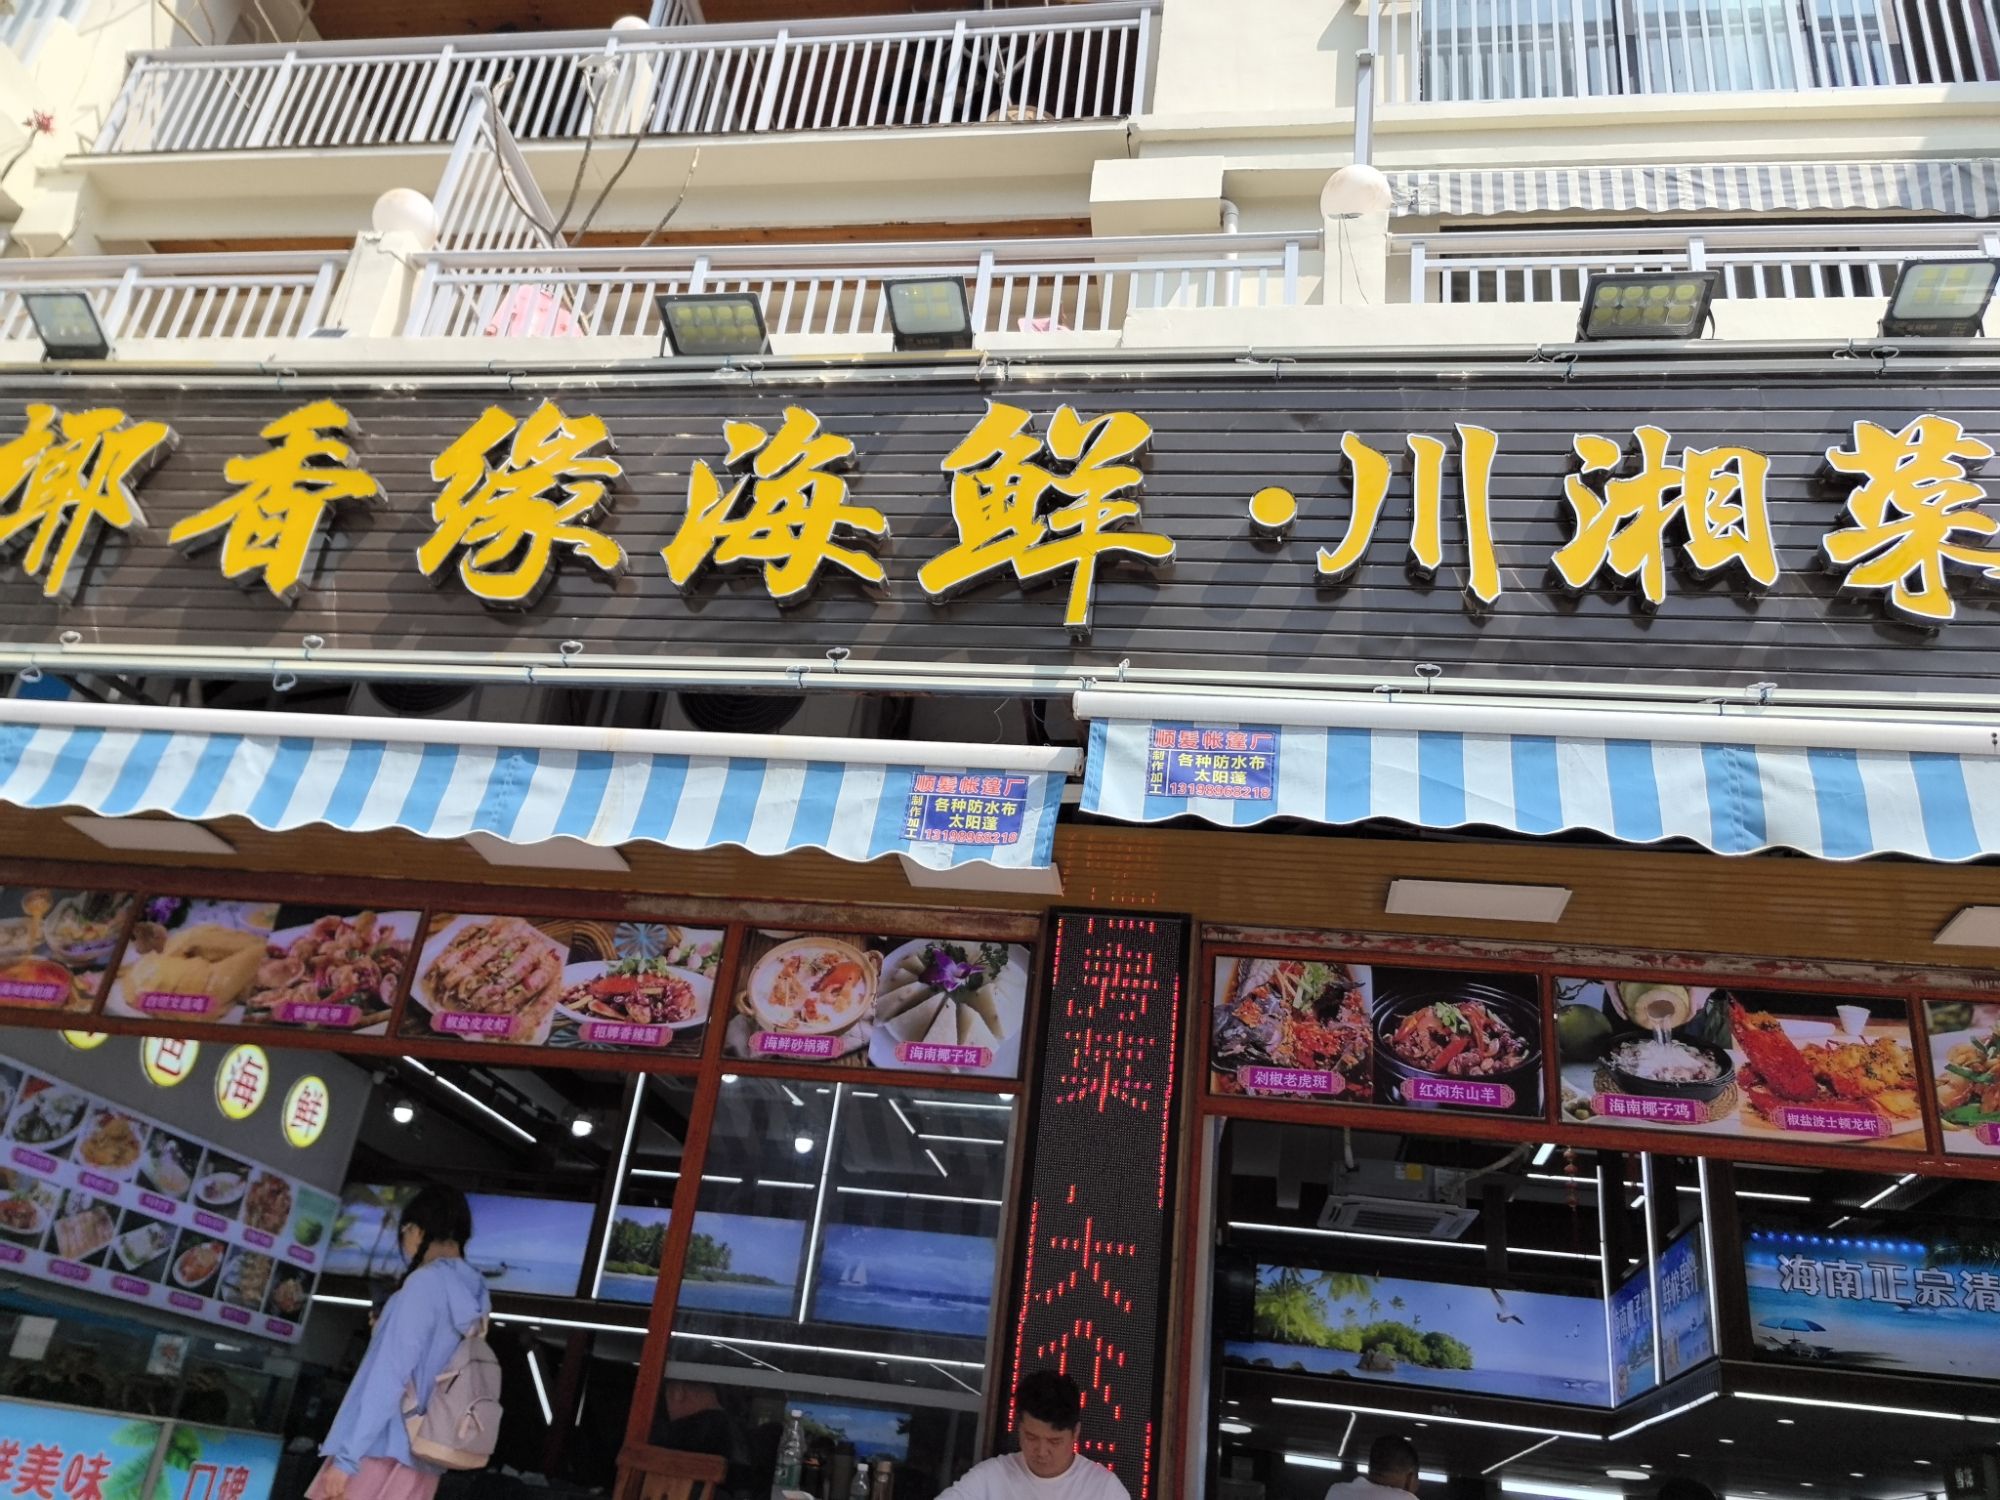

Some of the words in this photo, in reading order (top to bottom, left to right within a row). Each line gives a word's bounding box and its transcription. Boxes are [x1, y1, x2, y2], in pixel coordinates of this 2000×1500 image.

[1178, 752, 1266, 770] 各种防水布
[935, 798, 1018, 816] 各种防水布
[762, 1035, 830, 1053] 海鲜砂锅粥
[908, 1045, 978, 1065] 海南椰子饭
[1253, 1069, 1328, 1089] 剁椒老虎斑
[1418, 1082, 1497, 1102] 红焖东山羊
[1608, 1097, 1691, 1119] 海南椰子鸡
[1786, 1112, 1878, 1134] 椒盐波士顿龙虾
[1776, 1253, 2000, 1312] 海南正宗清
